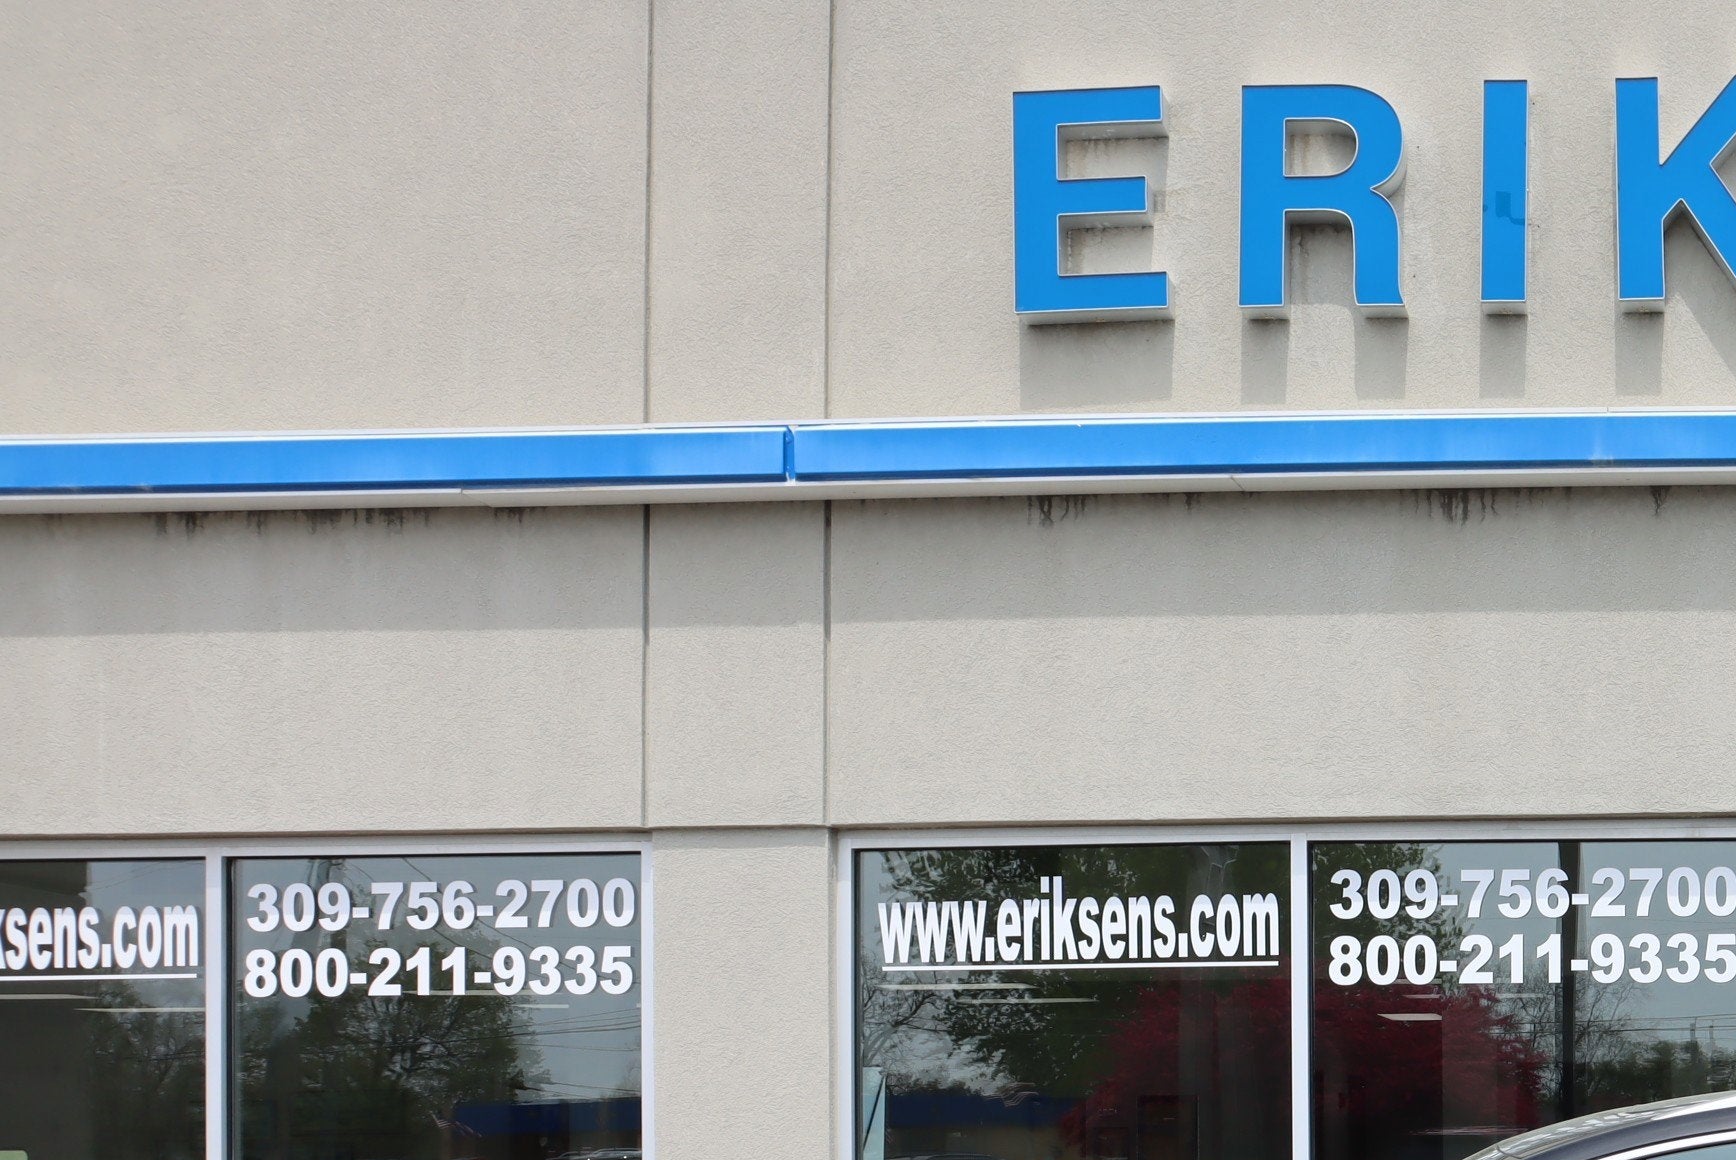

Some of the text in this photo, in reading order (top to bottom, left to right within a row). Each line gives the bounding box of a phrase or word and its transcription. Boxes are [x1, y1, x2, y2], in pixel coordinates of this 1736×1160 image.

[246, 877, 636, 933] 309-756-2700
[878, 876, 1281, 964] www.eriksens.com
[0, 904, 199, 970] sens.com
[244, 945, 633, 998] 800-211-9335
